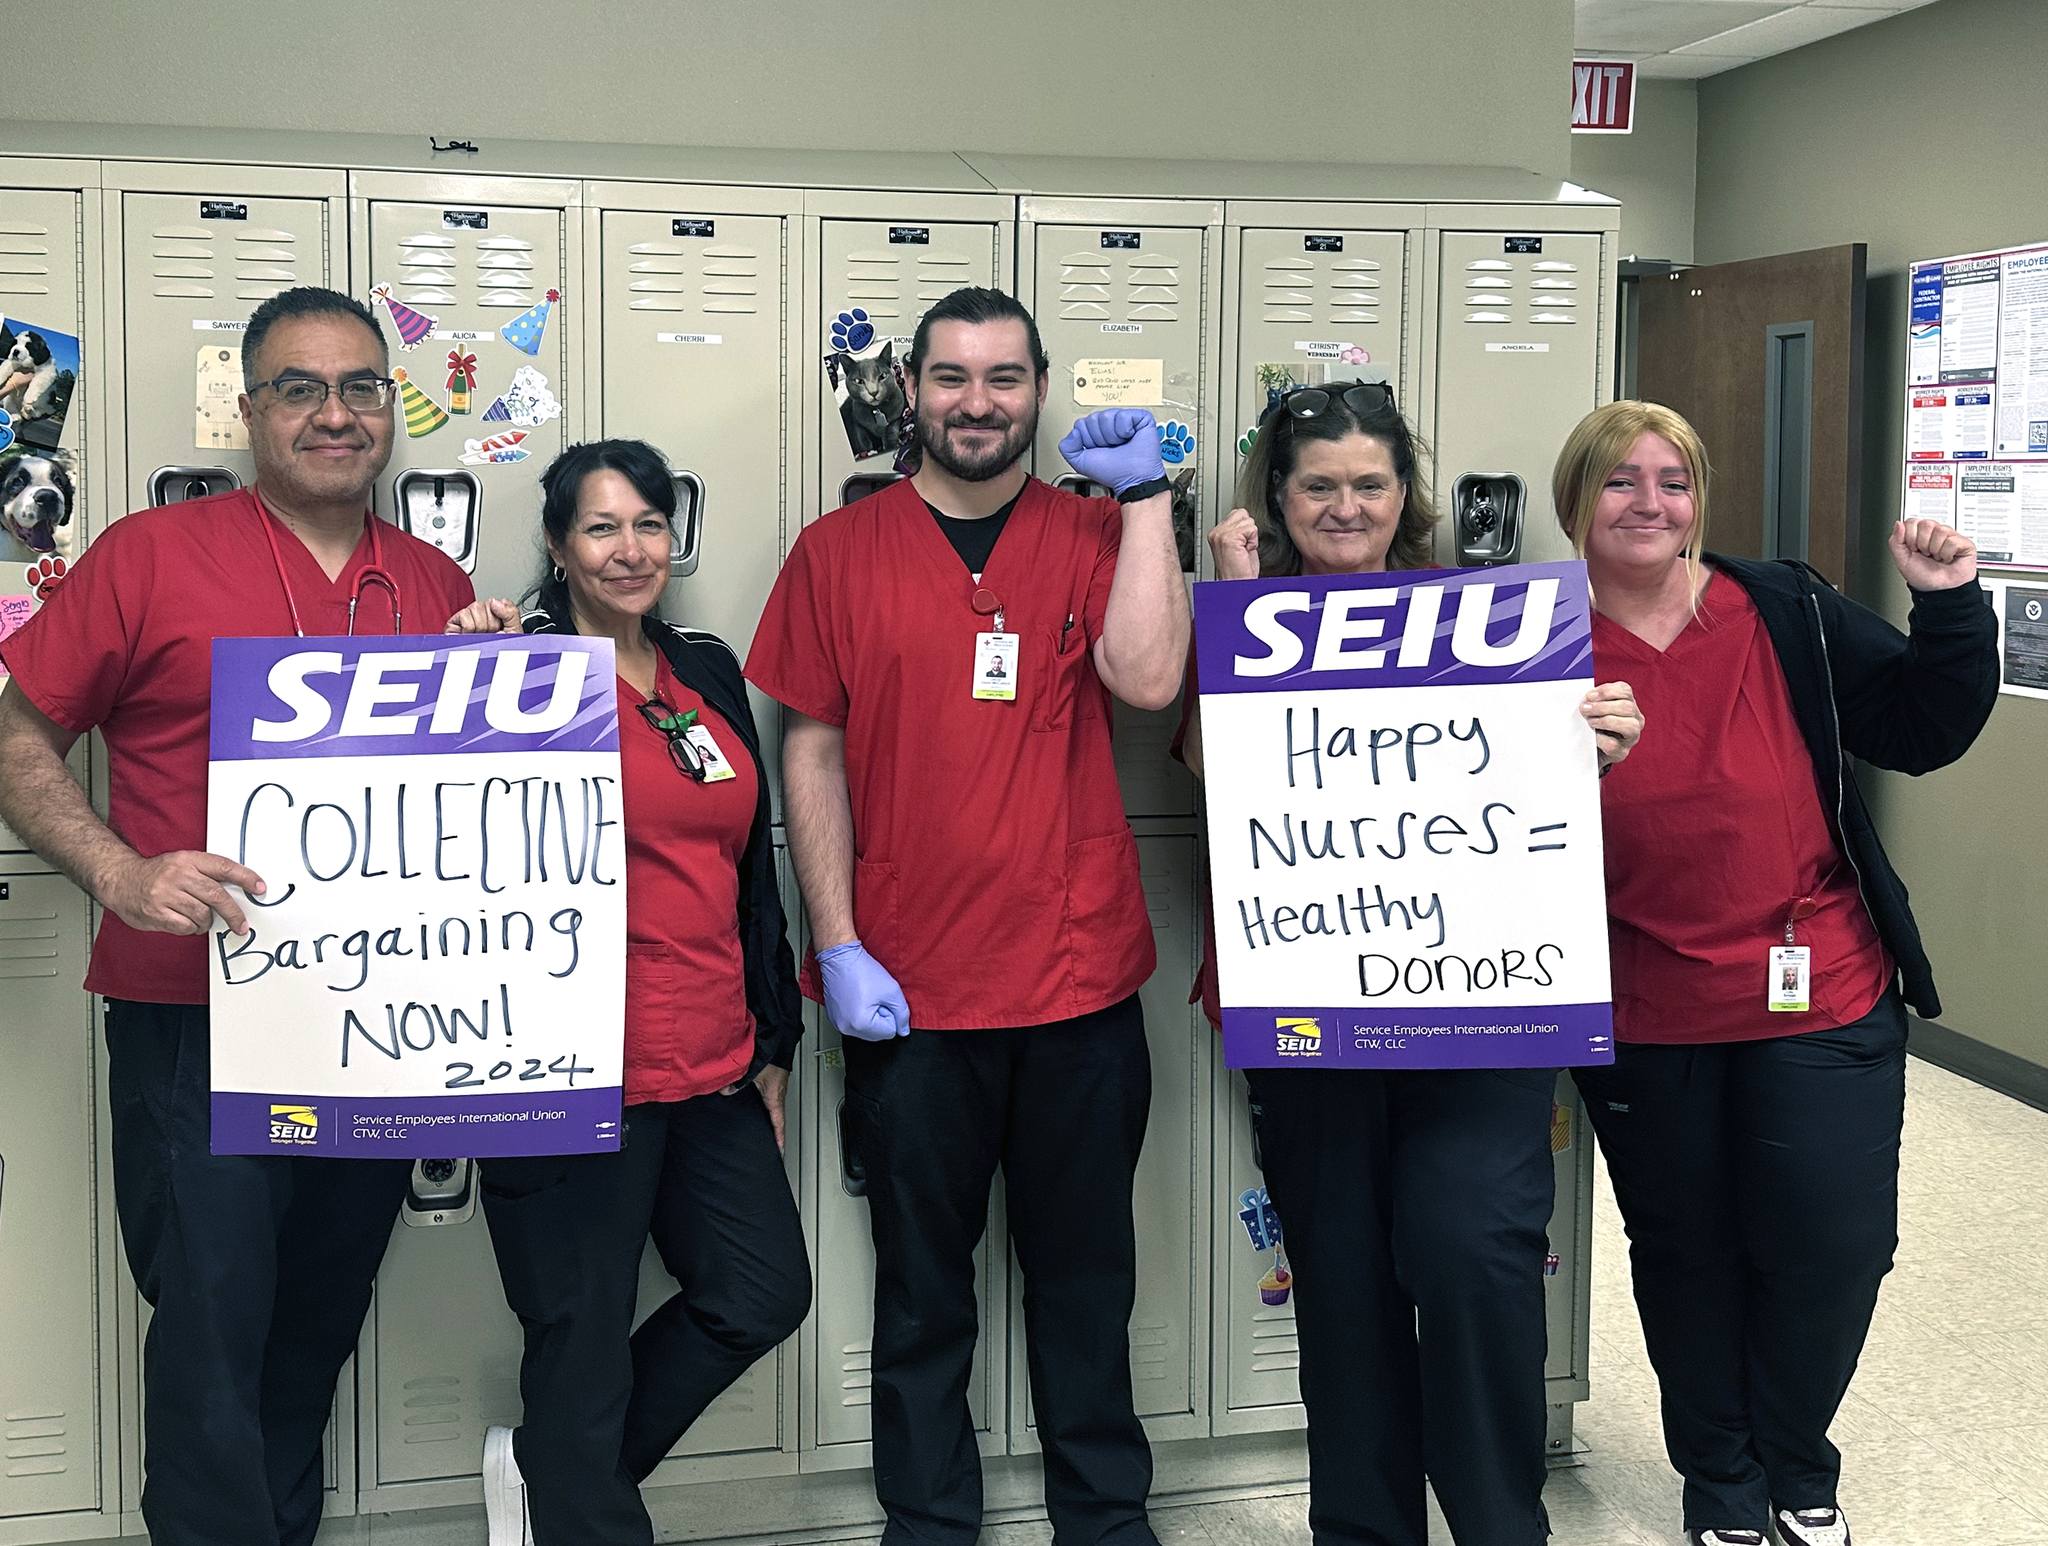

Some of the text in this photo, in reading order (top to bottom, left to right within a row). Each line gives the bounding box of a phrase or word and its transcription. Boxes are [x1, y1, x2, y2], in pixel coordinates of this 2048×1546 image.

[1571, 66, 1624, 124] XIT
[1945, 259, 1998, 274] EMPLOYEE RIGHTS
[1102, 324, 1140, 332] ELIZABETH
[452, 332, 477, 340] ALICIA
[674, 334, 705, 342] CHERRI
[1308, 342, 1341, 350] CHRISTY
[1965, 464, 2012, 472] EMPLOYEE RIGHTS
[1234, 578, 1560, 677] SEIU
[251, 650, 590, 742] SEIU
[1286, 707, 1490, 788] Happy
[239, 777, 617, 906] COLLECTIVE
[1250, 802, 1515, 869] Nurses
[1238, 884, 1446, 950] Healthy
[216, 908, 582, 991] Bargaining
[342, 984, 512, 1068] NOW!
[1354, 1023, 1558, 1037] Service Employees International Union
[1276, 1038, 1321, 1050] SEIU
[1355, 1039, 1406, 1050] CTW, CLC
[446, 1054, 594, 1088] 2024
[352, 1110, 566, 1126] Service Employees International Union
[269, 1126, 317, 1139] SEIU
[352, 1128, 408, 1140] CTW, CLC
